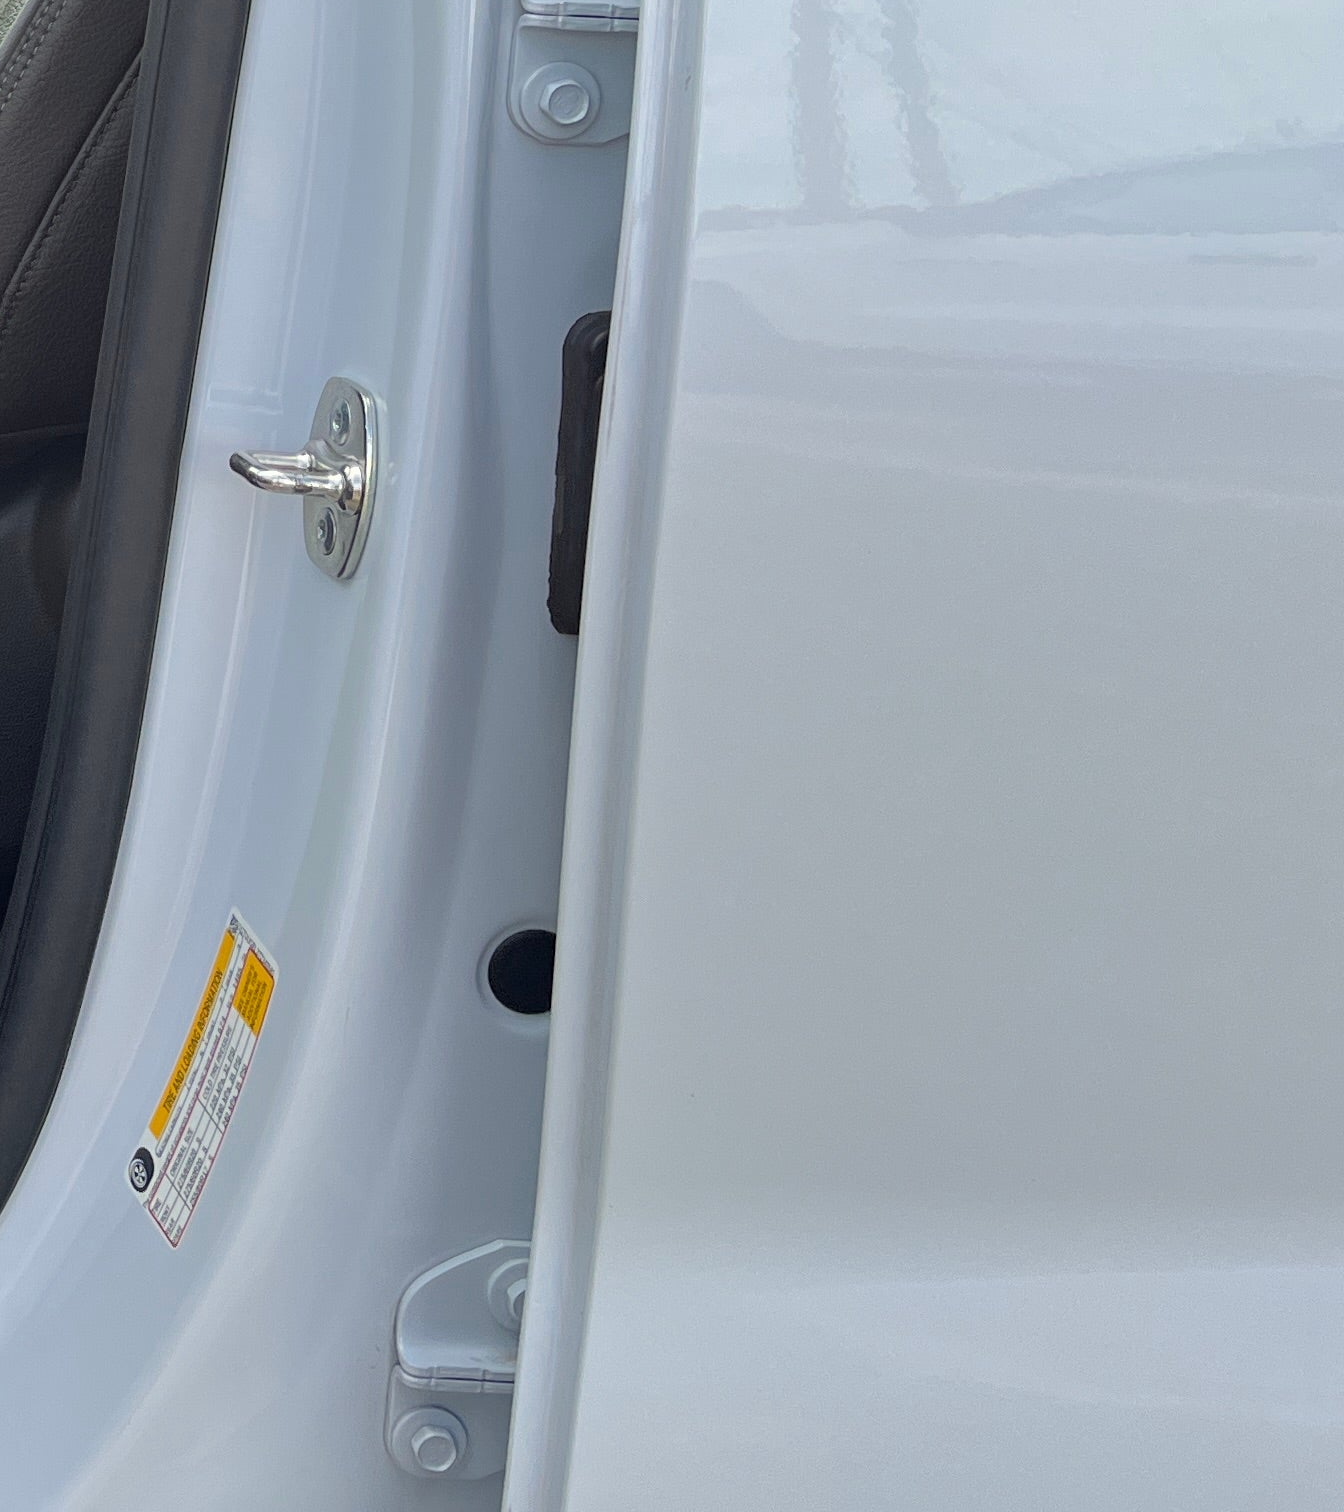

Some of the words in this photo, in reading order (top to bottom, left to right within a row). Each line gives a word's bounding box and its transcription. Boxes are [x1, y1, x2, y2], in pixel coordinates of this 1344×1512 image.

[163, 1090, 176, 1114] TIRE
[172, 1068, 184, 1093] AND
[182, 1030, 200, 1073] LOADING
[198, 969, 223, 1031] INFORMATION
